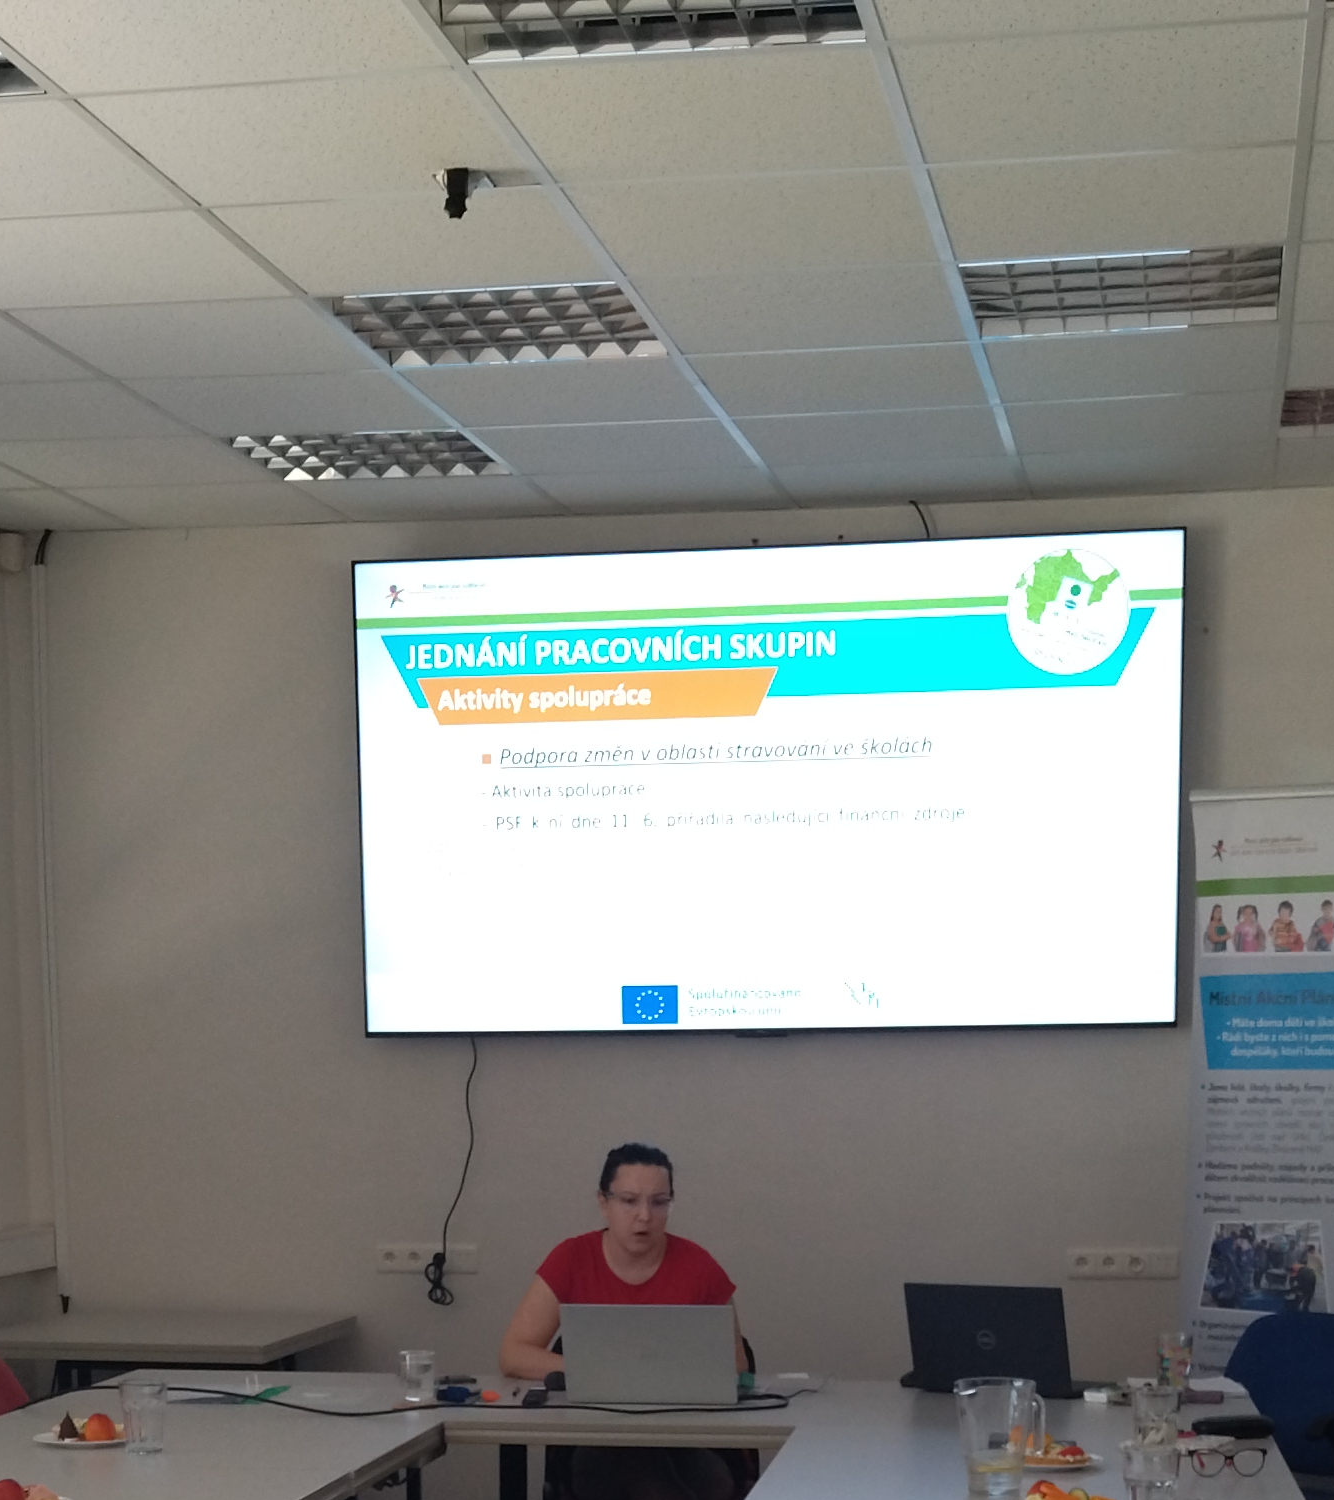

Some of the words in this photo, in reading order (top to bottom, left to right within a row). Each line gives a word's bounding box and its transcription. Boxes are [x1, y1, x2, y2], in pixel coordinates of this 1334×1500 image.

[405, 633, 528, 670] JEDNÁNÍ
[534, 628, 722, 666] PRACOVNÍCH
[729, 629, 836, 660] SKUPIN
[437, 686, 524, 714] Aktivity
[528, 682, 652, 713] spolupráce
[499, 747, 578, 768] Podpora
[584, 746, 634, 763] změn
[641, 749, 651, 761] v
[656, 743, 721, 761] oblasti
[726, 739, 829, 759] stravování
[833, 742, 854, 756] ve
[860, 737, 933, 755] školách
[492, 784, 551, 799] Aktivita
[496, 815, 522, 830] PSF
[532, 814, 539, 829] k
[571, 814, 601, 829] dne
